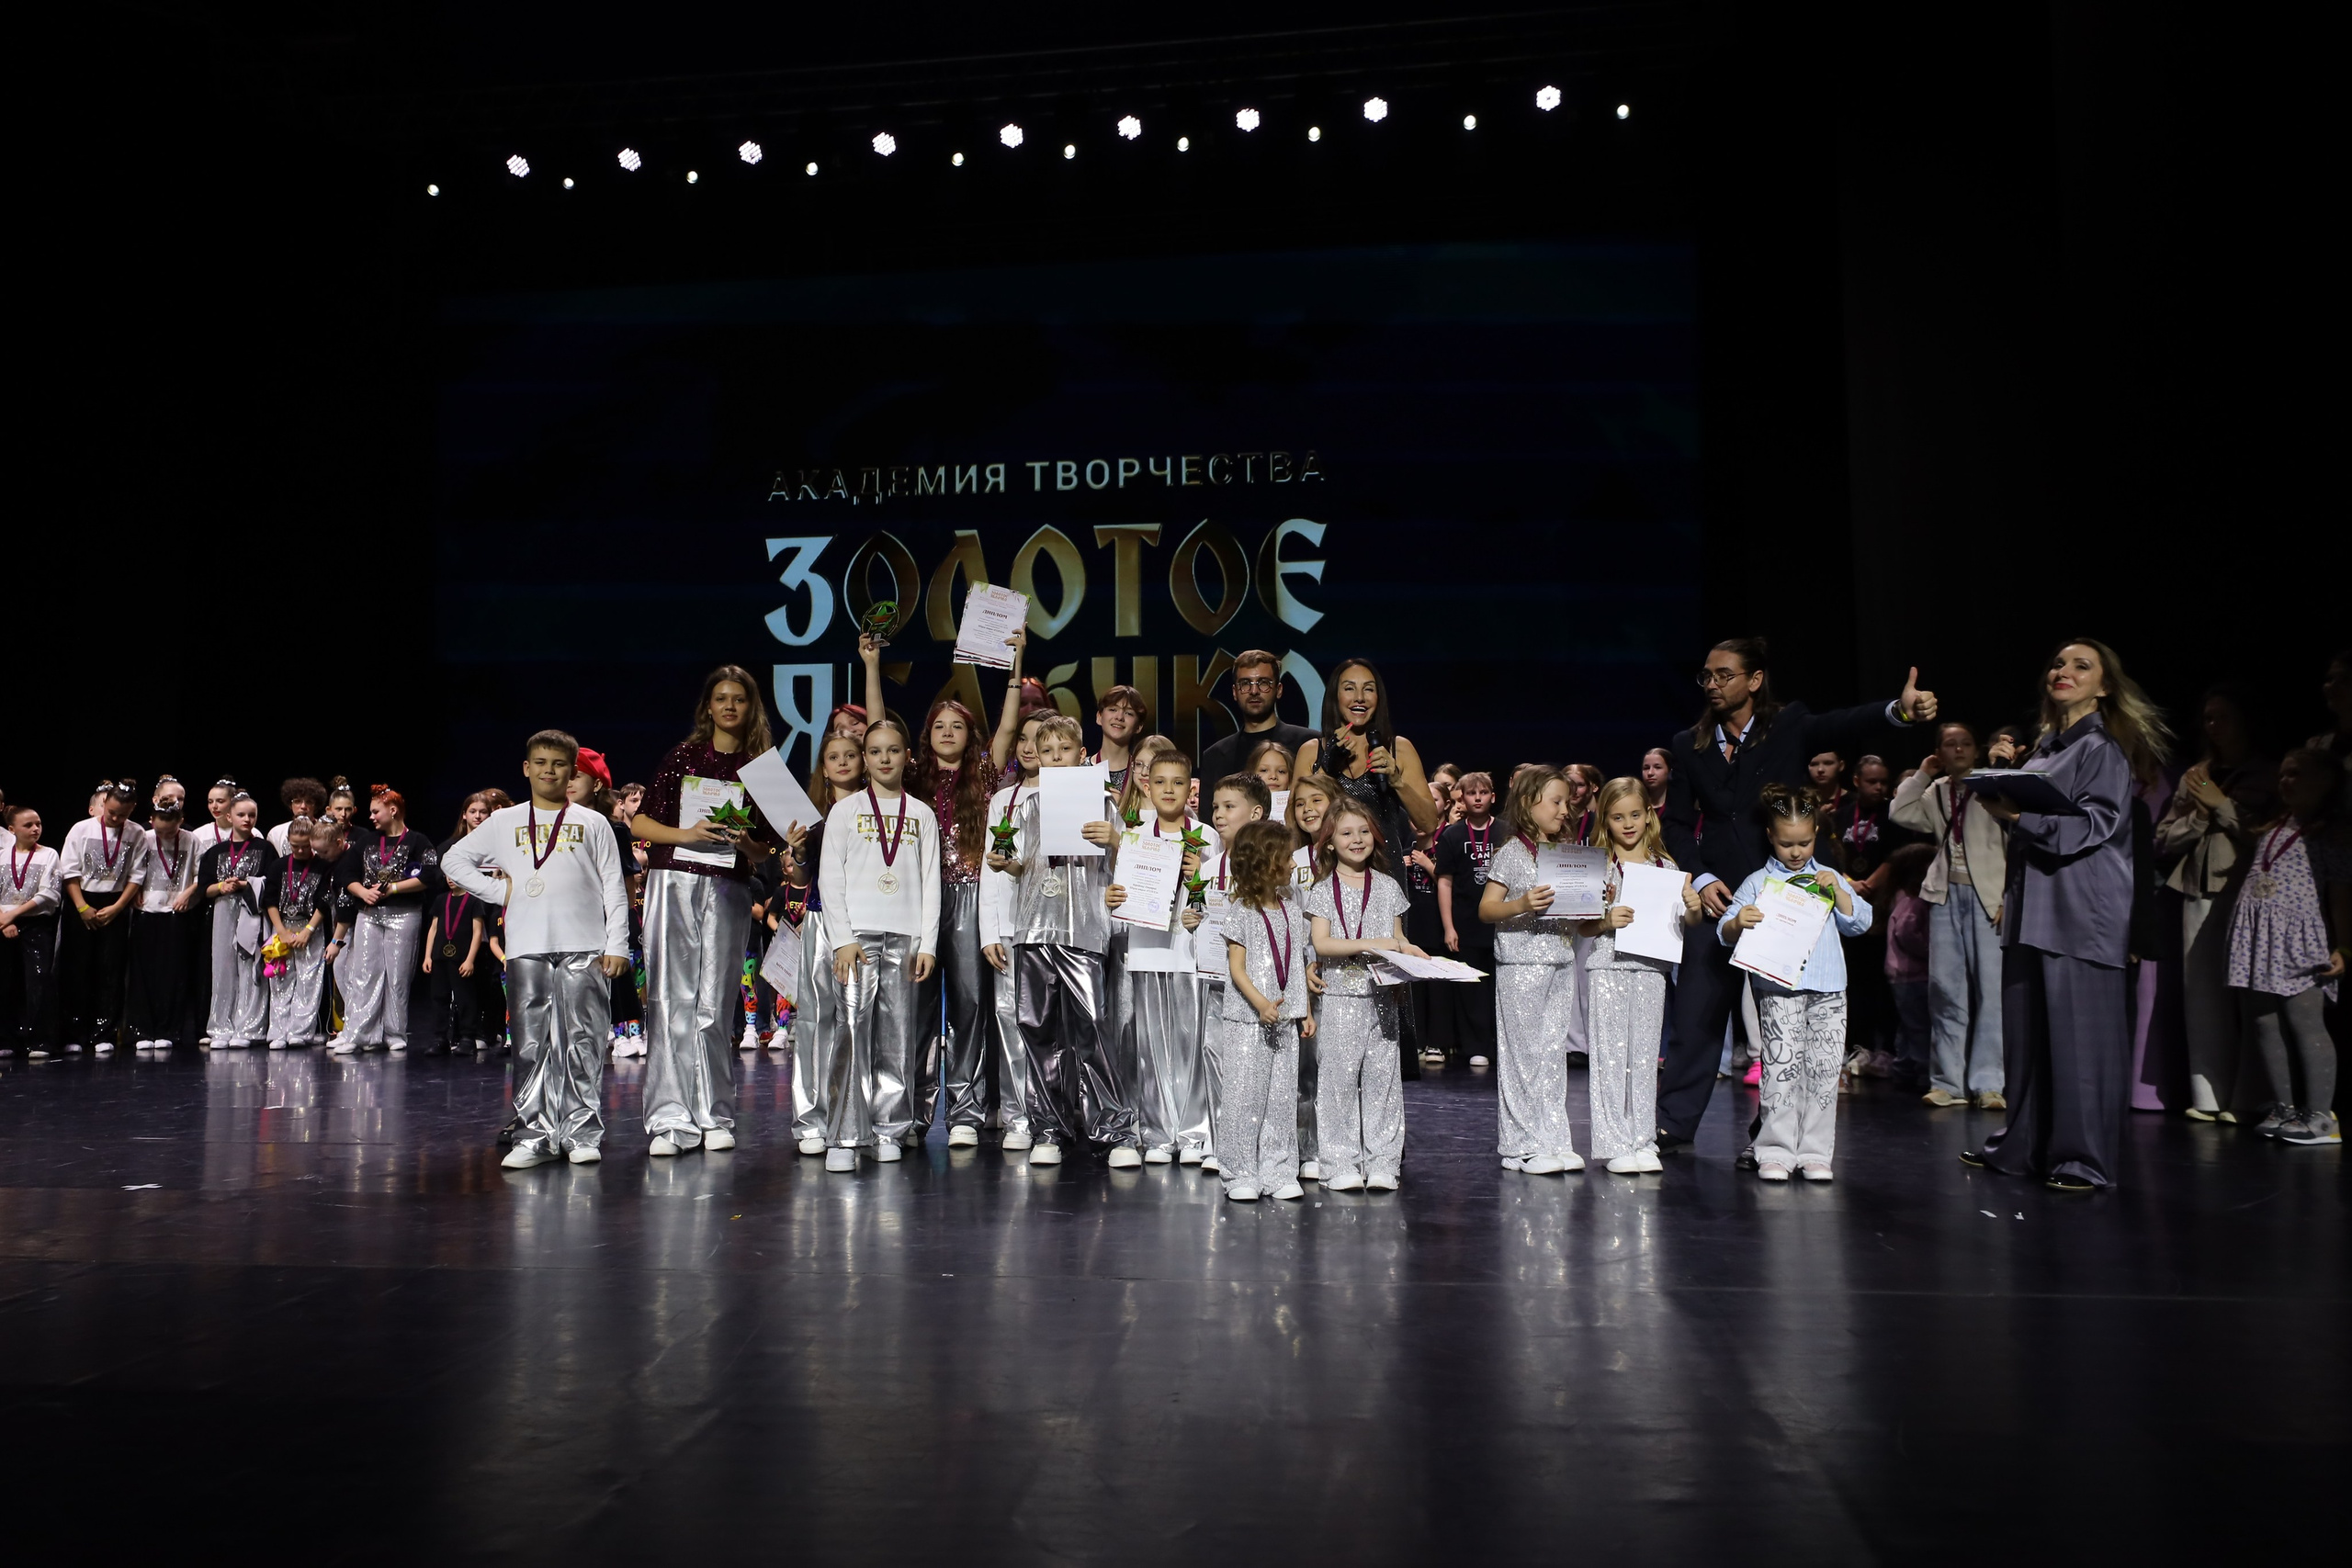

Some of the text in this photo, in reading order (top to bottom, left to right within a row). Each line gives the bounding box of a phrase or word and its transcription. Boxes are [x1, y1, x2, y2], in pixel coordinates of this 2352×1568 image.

[768, 449, 1327, 505] АКАДЕМИЯ ТВОРЧЕСТВА
[764, 517, 1329, 647] ЗОЛОТОЕ
[518, 825, 580, 843] GLSA
[862, 816, 917, 835] GOOSA
[1134, 863, 1161, 873] ДИПЛОМ
